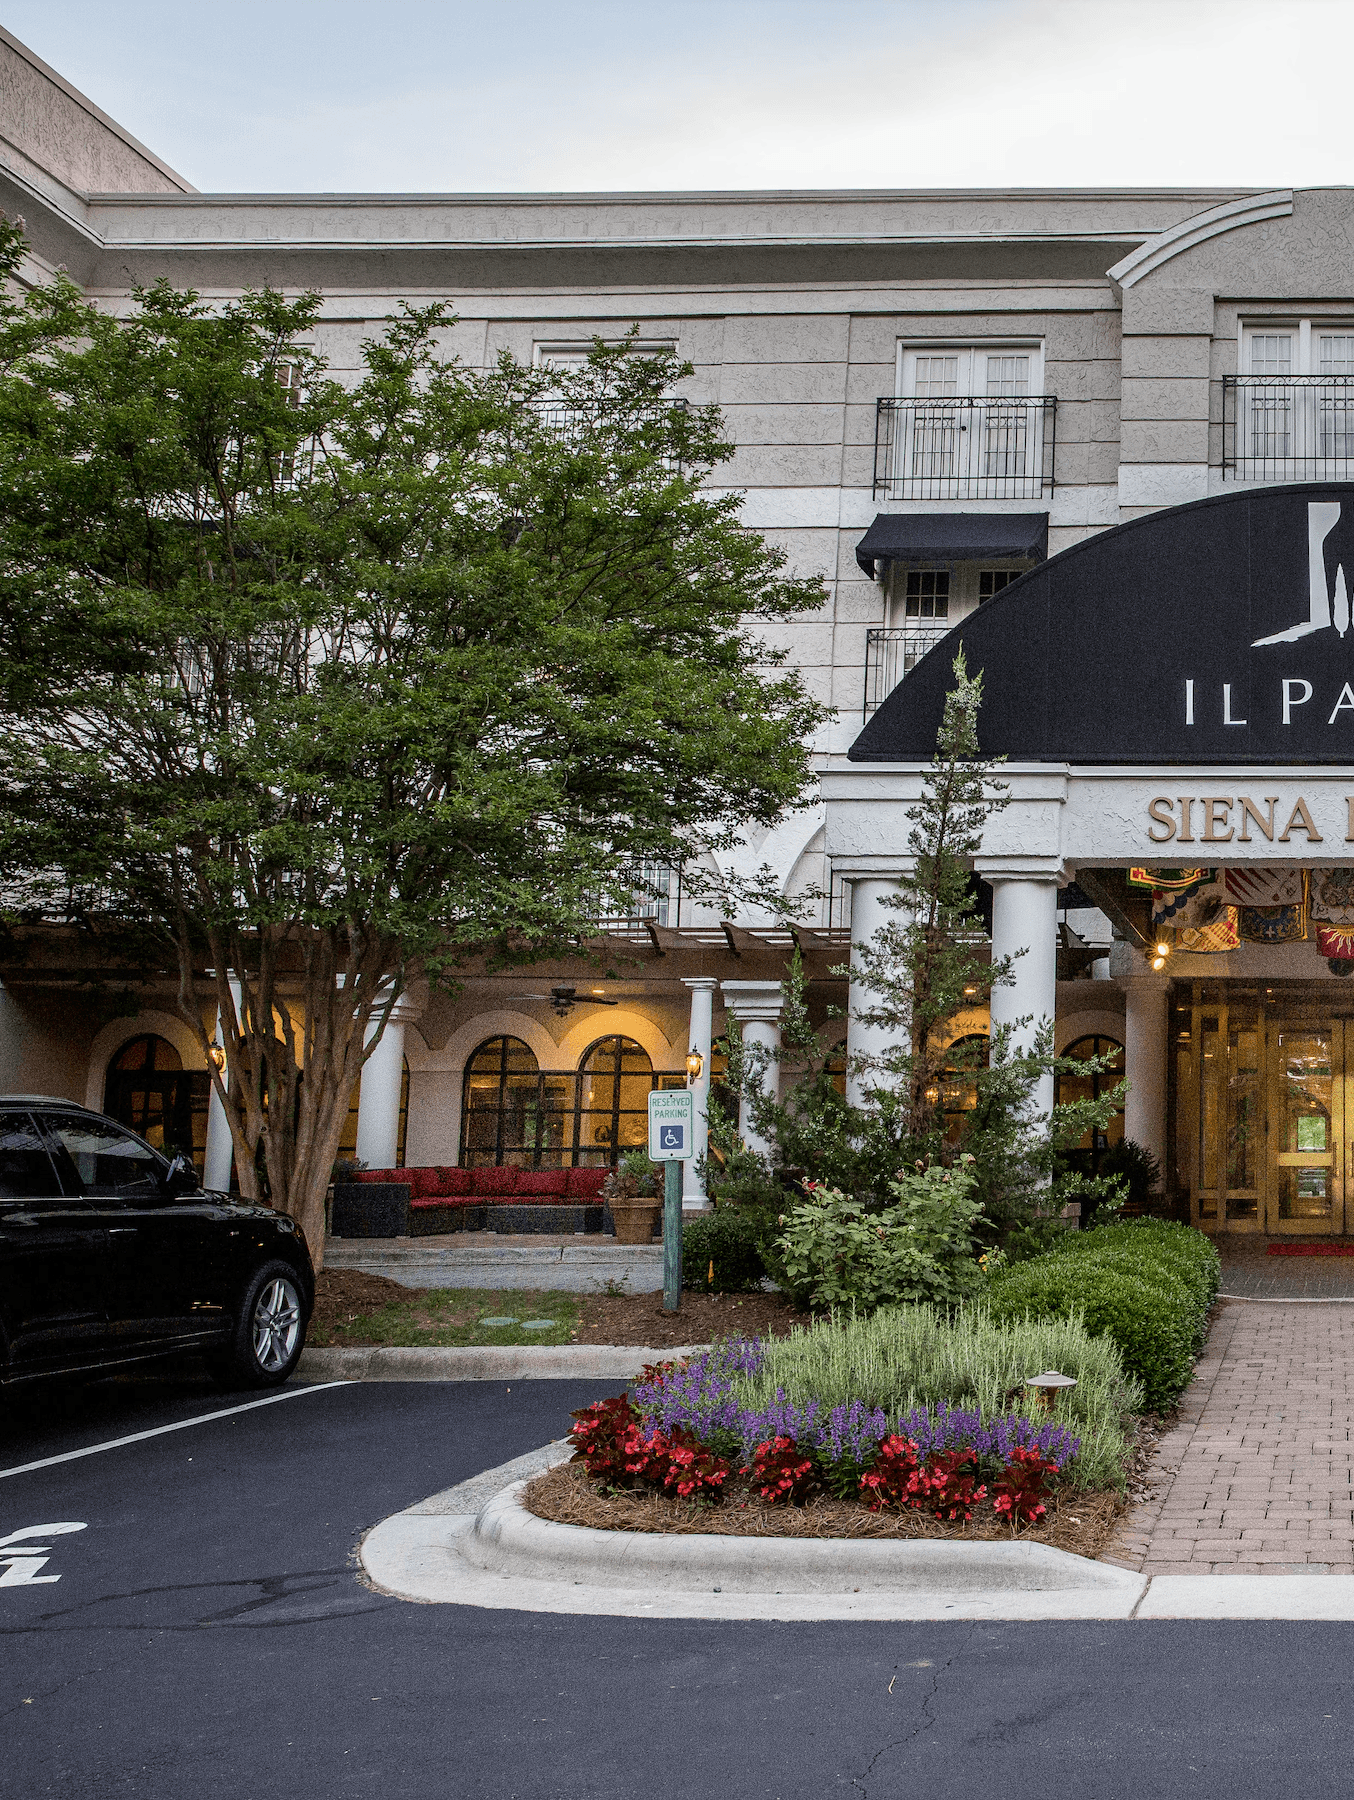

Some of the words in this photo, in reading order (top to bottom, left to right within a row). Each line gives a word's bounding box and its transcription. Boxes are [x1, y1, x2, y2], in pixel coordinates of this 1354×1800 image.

[1185, 678, 1247, 725] IL
[1147, 796, 1324, 843] SIENA
[652, 1097, 690, 1107] RESERVED
[654, 1109, 688, 1118] PARKING
